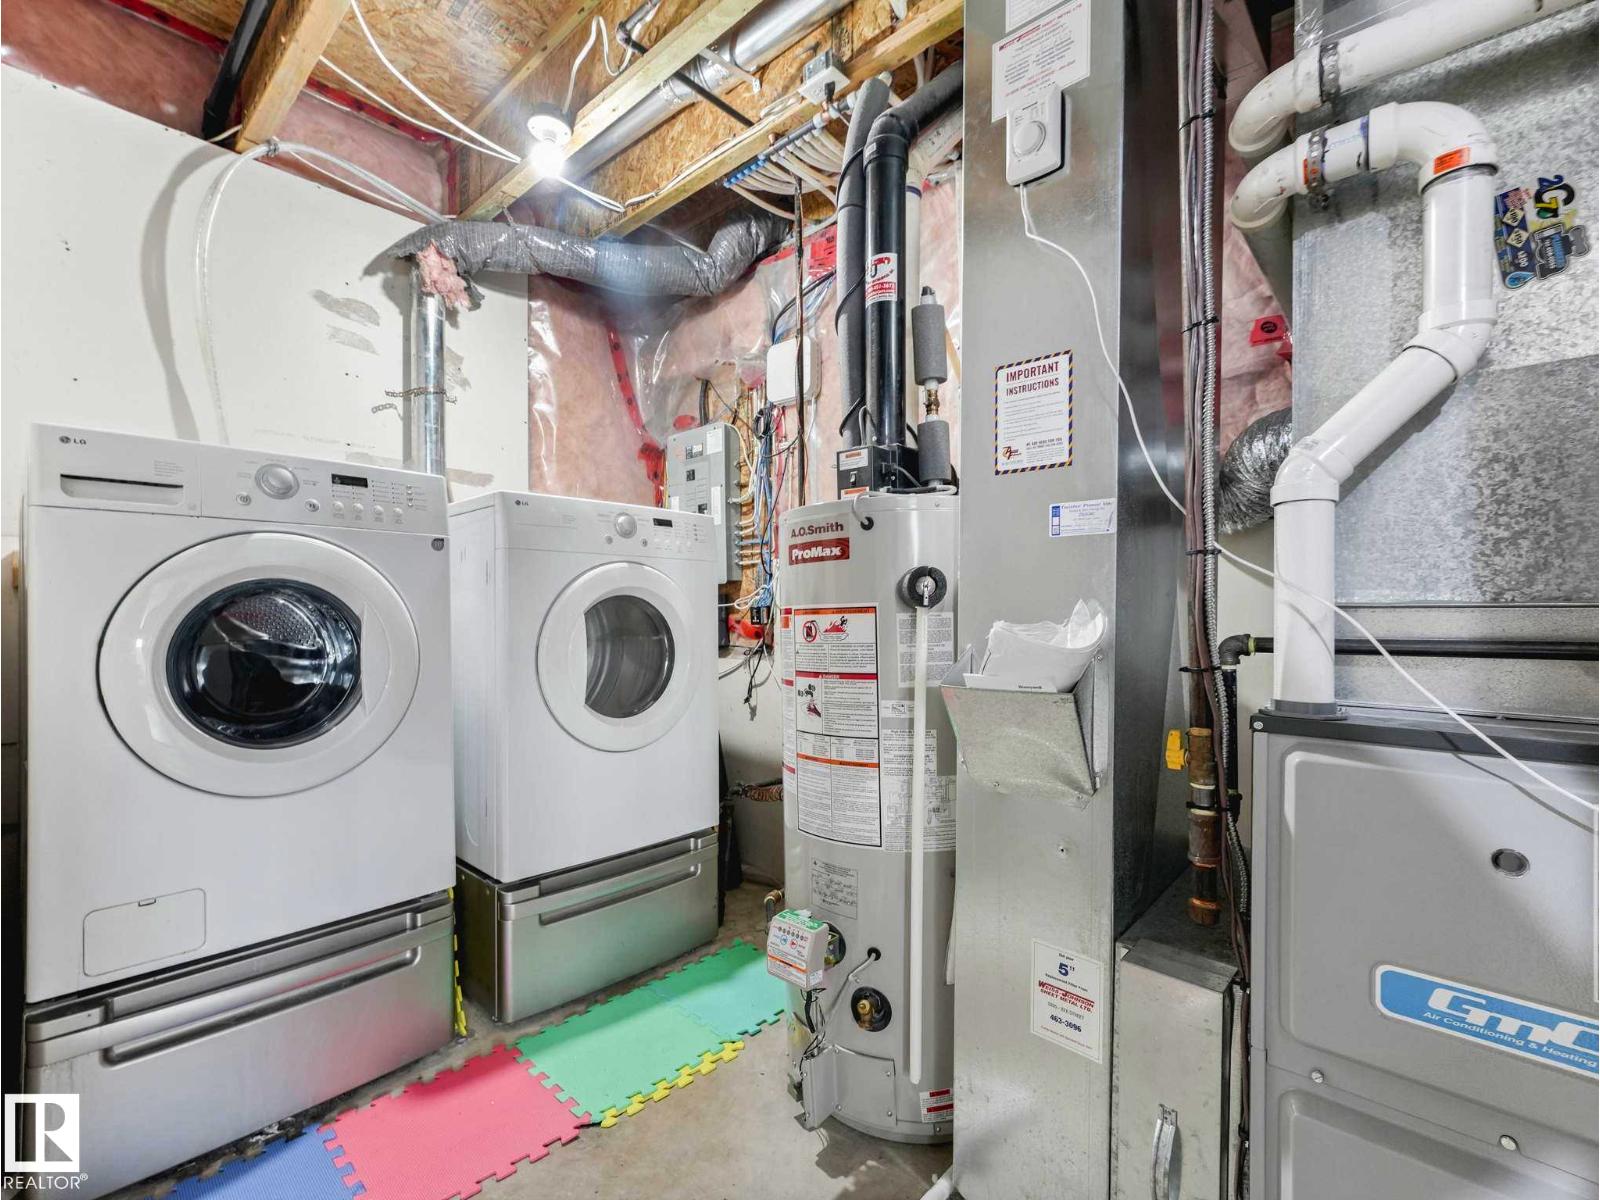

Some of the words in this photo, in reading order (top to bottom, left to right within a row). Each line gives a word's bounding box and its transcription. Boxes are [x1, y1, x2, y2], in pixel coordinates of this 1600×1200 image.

[1006, 361, 1060, 383] IMPORTANT
[1006, 377, 1060, 396] INSTRUCTIONS
[791, 522, 844, 539] A.O.Smith
[791, 546, 842, 561] ProMax
[1040, 988, 1059, 999] SHEET
[1060, 995, 1079, 1007] METAL
[1423, 1011, 1442, 1021] Air
[1443, 1016, 1525, 1046] Conditioning
[1528, 1041, 1538, 1049] &
[1542, 1045, 1598, 1068] Heating
